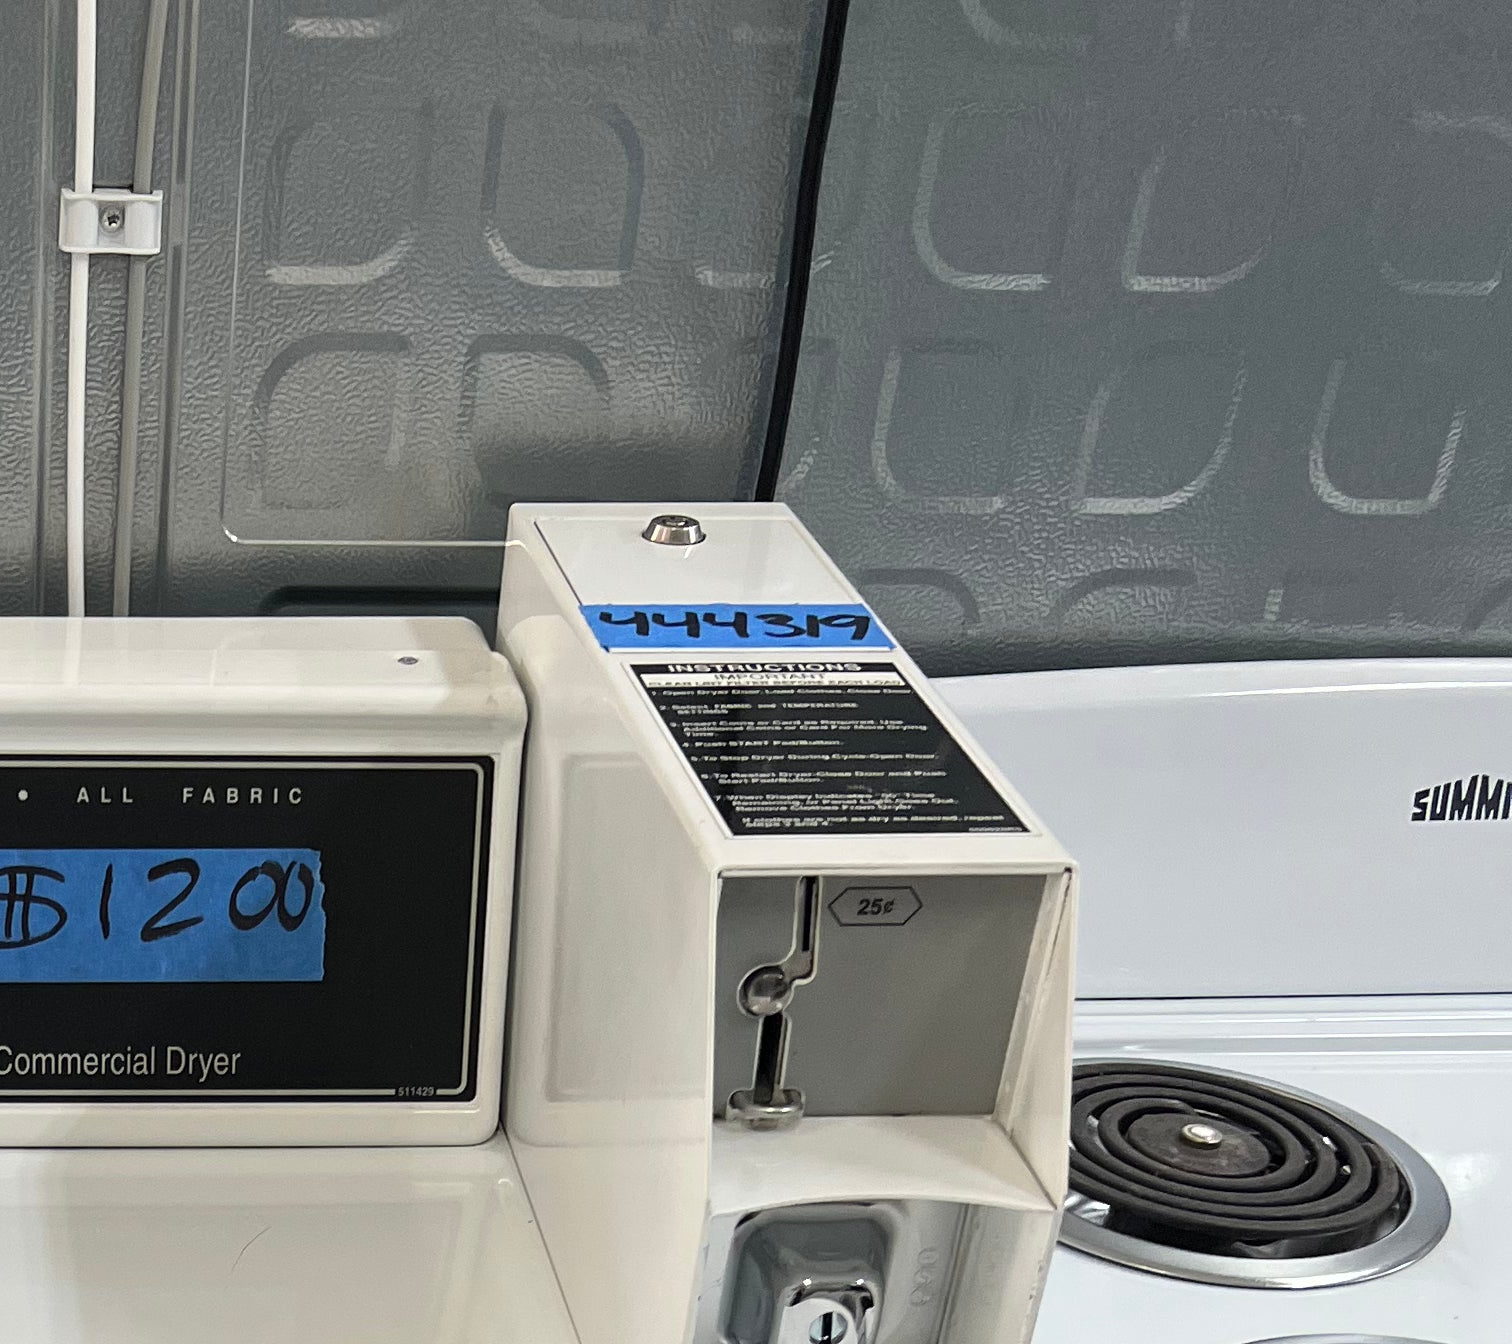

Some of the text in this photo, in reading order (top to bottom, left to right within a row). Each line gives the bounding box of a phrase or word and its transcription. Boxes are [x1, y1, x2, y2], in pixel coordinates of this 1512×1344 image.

[598, 610, 872, 642] 444319
[668, 663, 862, 673] INSTRUCTIONS
[76, 787, 134, 804] ALL
[182, 787, 303, 805] FABRIC
[1411, 774, 1512, 822] SUMMI
[166, 1046, 241, 1083] Dryer
[397, 1086, 435, 1098] 511429
